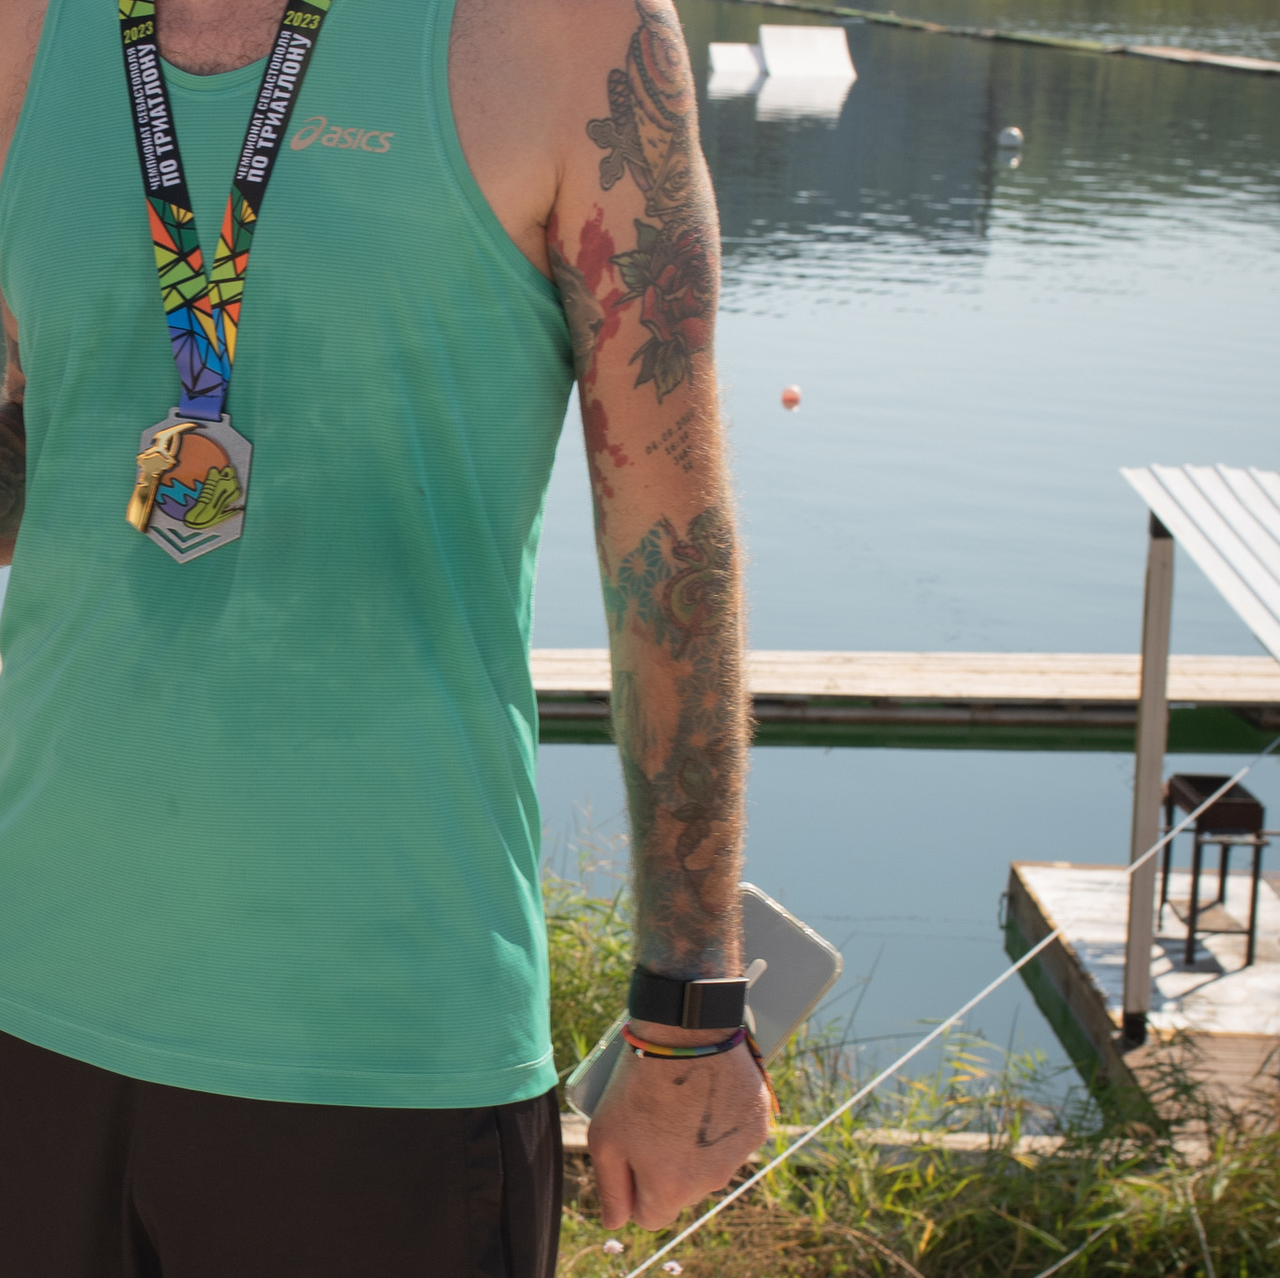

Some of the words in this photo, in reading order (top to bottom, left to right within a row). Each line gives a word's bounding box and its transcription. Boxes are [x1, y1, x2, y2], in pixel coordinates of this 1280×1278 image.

[123, 21, 154, 44] 2023
[283, 10, 321, 30] 2023
[126, 46, 150, 124] СЕВАСТОПОЛЯ
[137, 43, 174, 156] ТРИАТЛОНУ
[236, 112, 266, 180] ЧЕМПИОНАТ
[257, 30, 293, 111] СЕВАСТОПОЛЯ
[256, 33, 313, 148] ТРИАТЛОНУ
[139, 126, 161, 191] ЧЕМПИОНАТ
[159, 158, 182, 188] ПО
[246, 154, 269, 183] ПО
